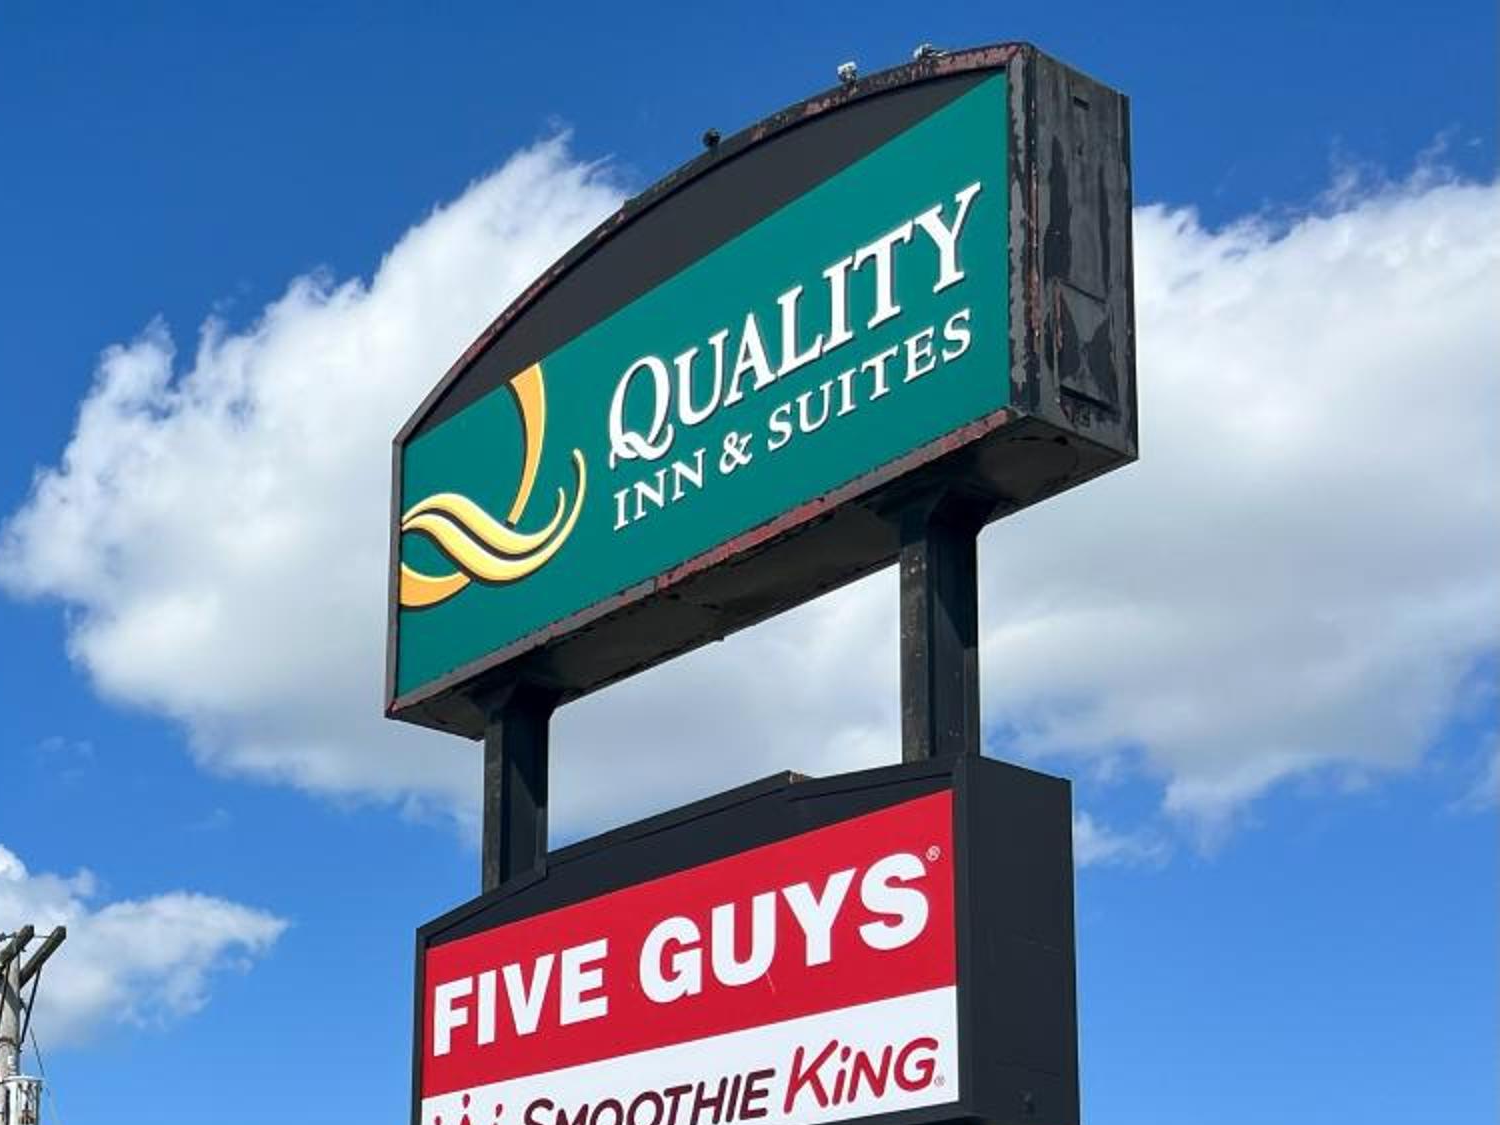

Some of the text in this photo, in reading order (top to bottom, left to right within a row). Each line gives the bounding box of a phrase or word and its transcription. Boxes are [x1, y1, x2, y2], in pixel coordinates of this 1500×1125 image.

[609, 182, 982, 470] QUALITY
[613, 308, 973, 532] INN & SUITES
[433, 853, 930, 1057] FIVE GUYS
